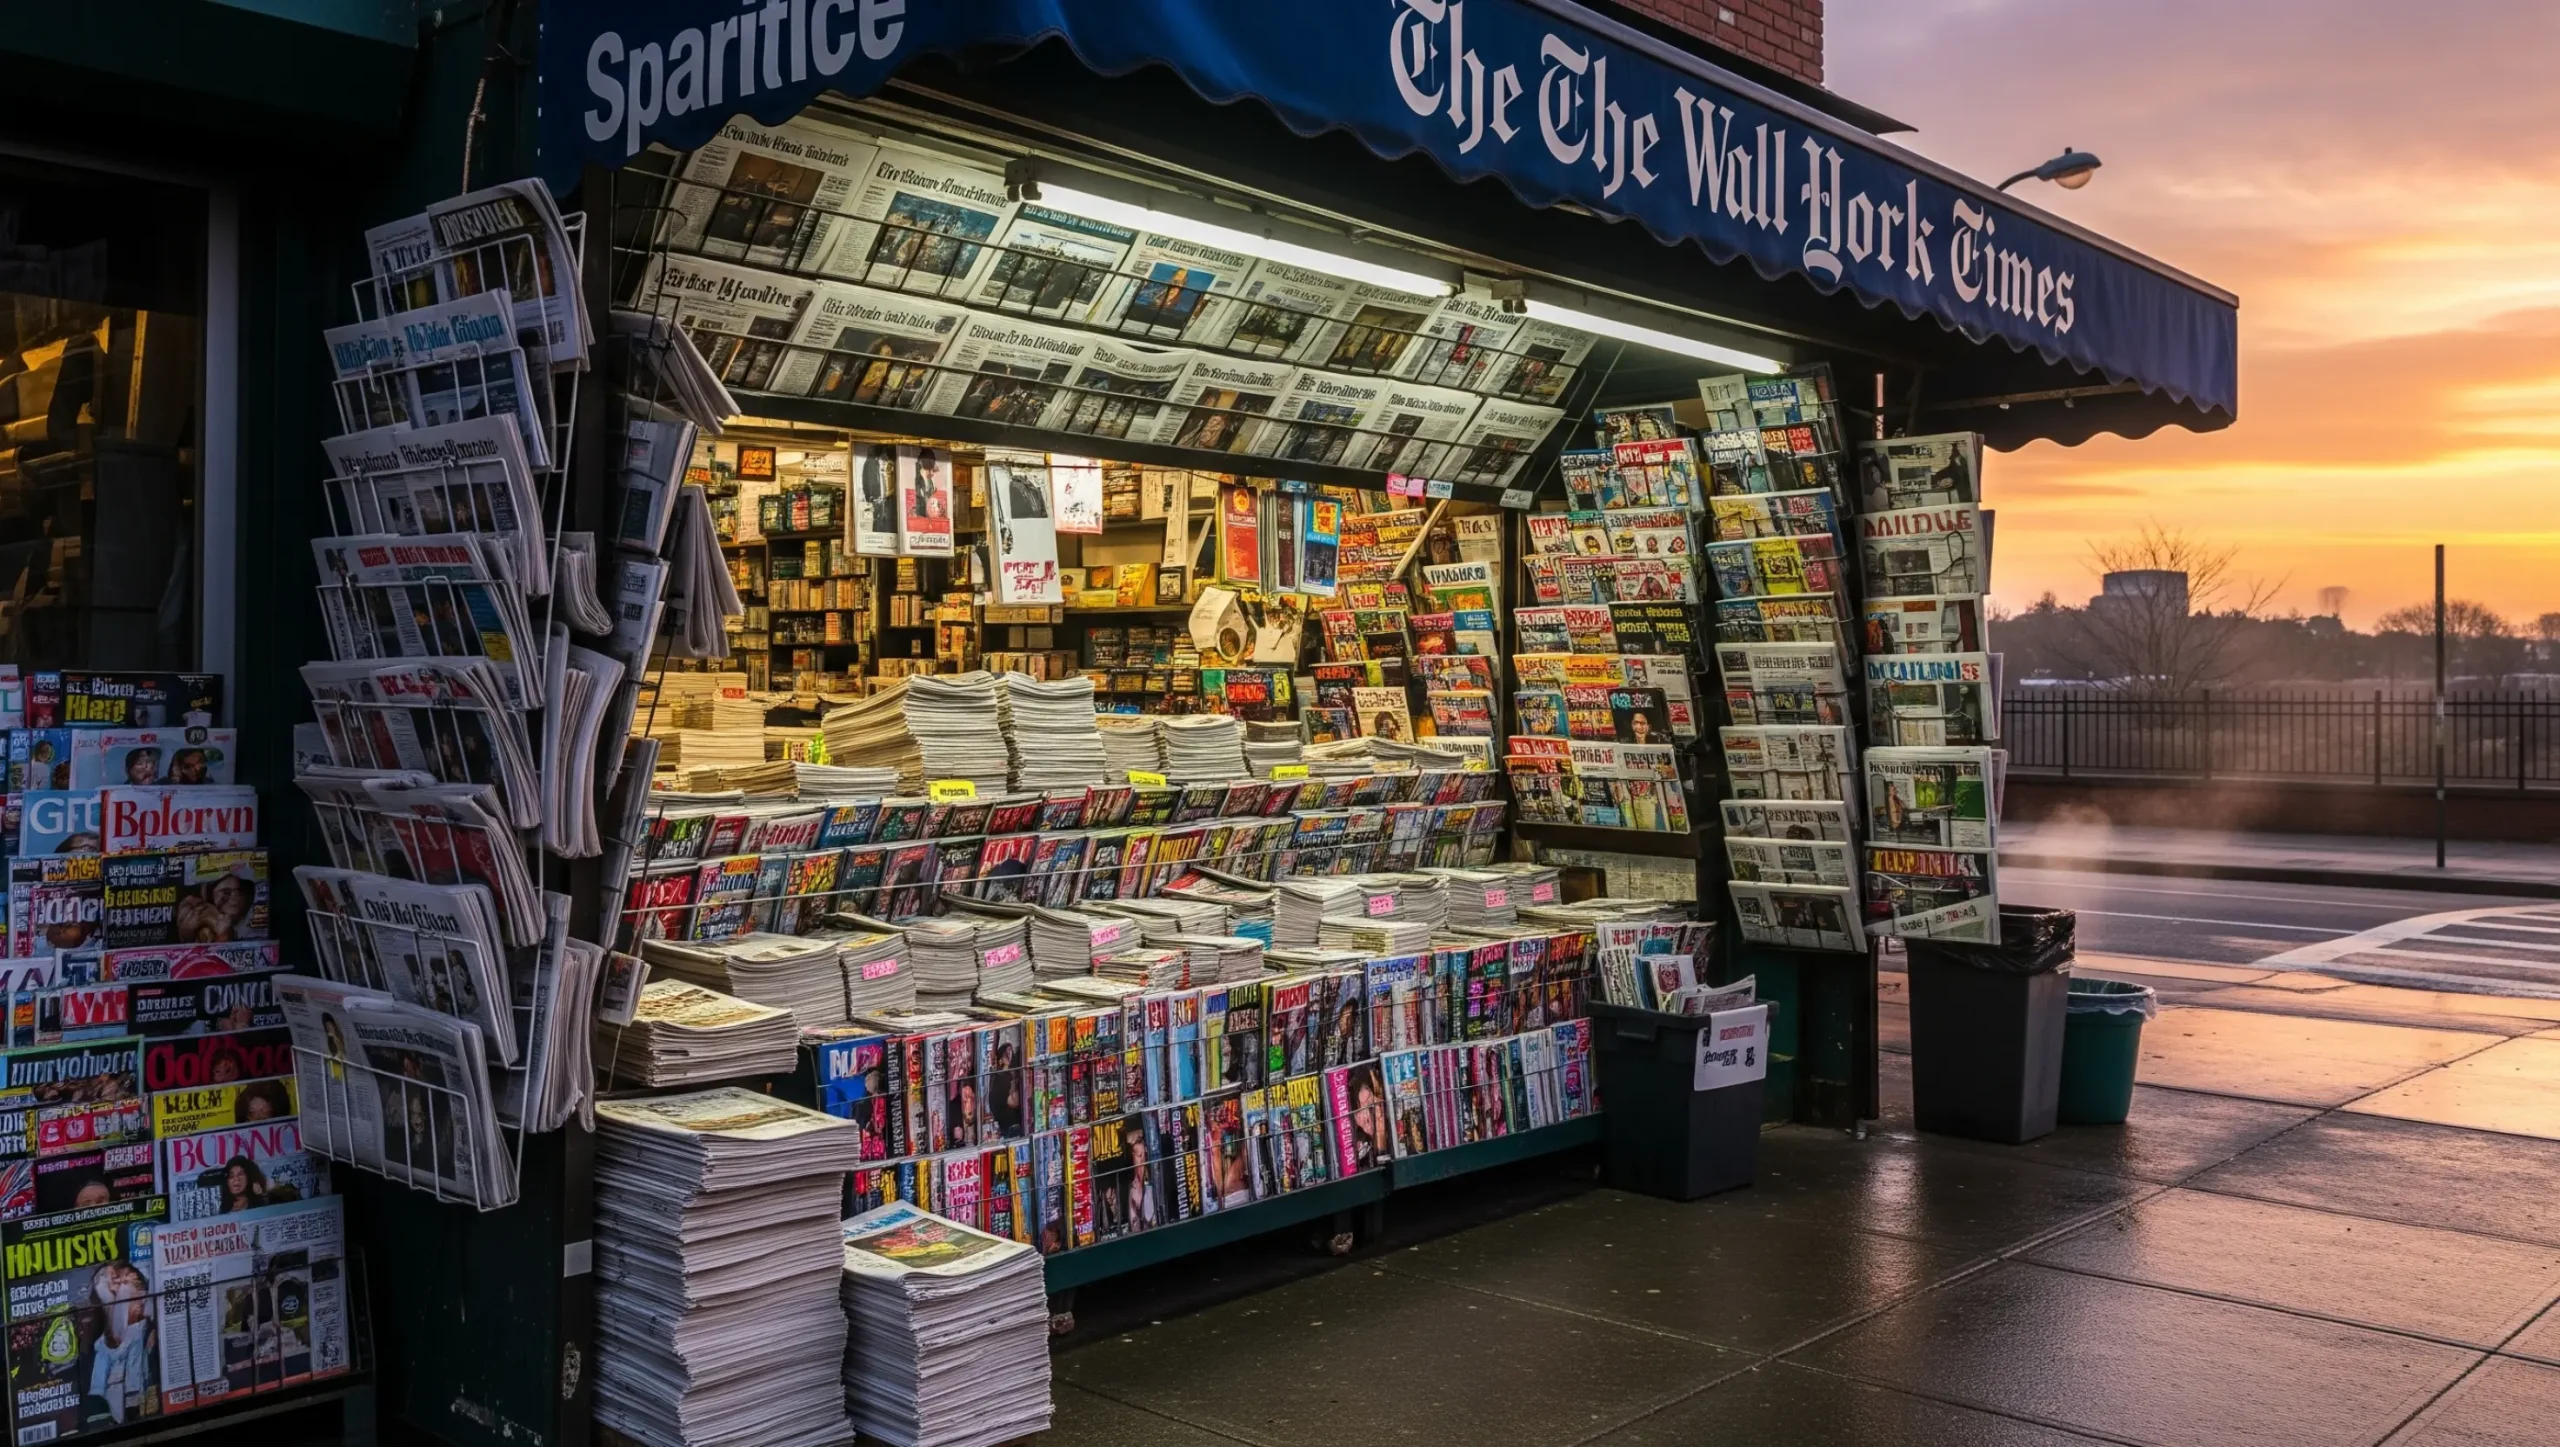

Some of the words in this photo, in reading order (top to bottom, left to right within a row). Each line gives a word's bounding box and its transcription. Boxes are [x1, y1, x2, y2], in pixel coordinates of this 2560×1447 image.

[1388, 0, 1524, 155] The
[1538, 33, 1661, 200] The
[1673, 86, 1789, 236] Wall
[1801, 136, 1936, 286] York
[1950, 198, 2076, 338] Times
